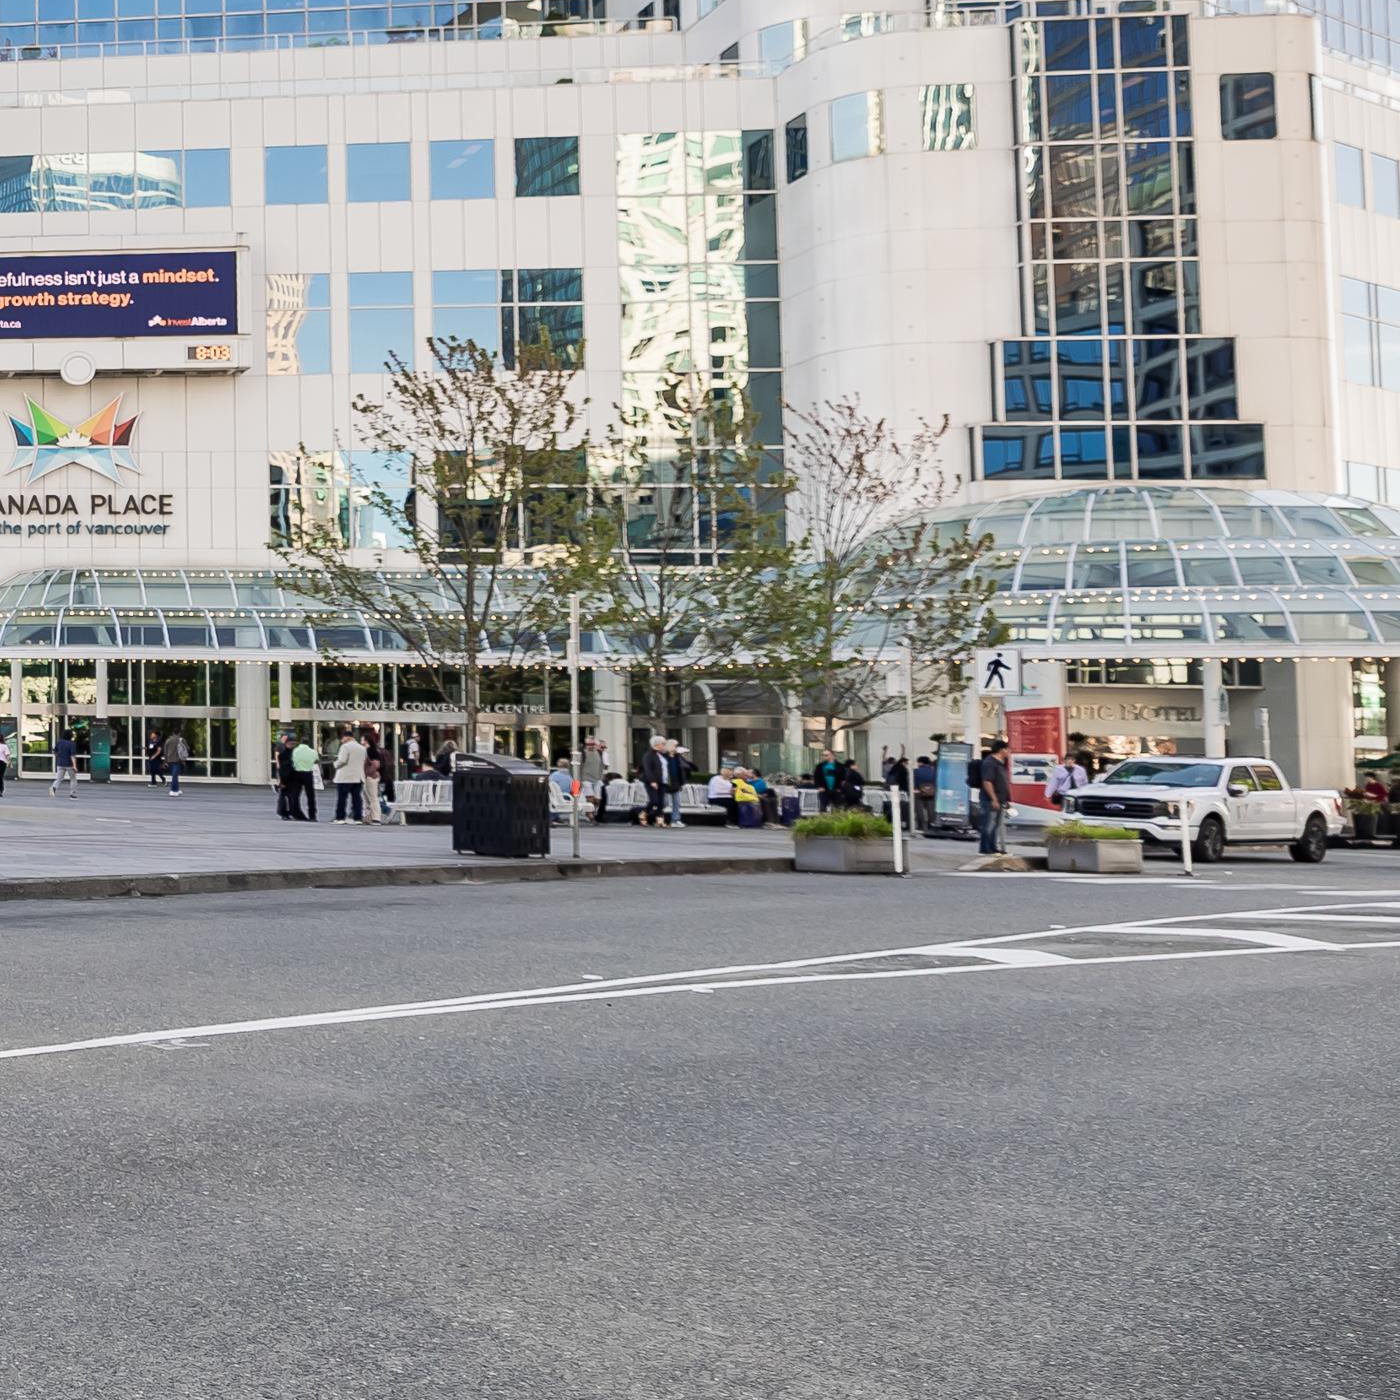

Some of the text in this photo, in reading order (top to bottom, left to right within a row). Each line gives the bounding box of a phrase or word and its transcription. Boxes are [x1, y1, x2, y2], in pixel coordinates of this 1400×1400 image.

[64, 270, 94, 285] isn't
[97, 270, 126, 288] just
[128, 273, 139, 284] a
[142, 268, 219, 284] mindset.
[57, 291, 134, 309] strategy.
[195, 347, 231, 360] 8:03
[90, 494, 174, 515] PLACE
[28, 522, 61, 538] port
[66, 521, 81, 535] of
[86, 524, 171, 535] vancouver
[318, 700, 397, 711] VANCOUVER
[494, 703, 546, 714] CENTRE
[1120, 703, 1202, 721] HOTEL
